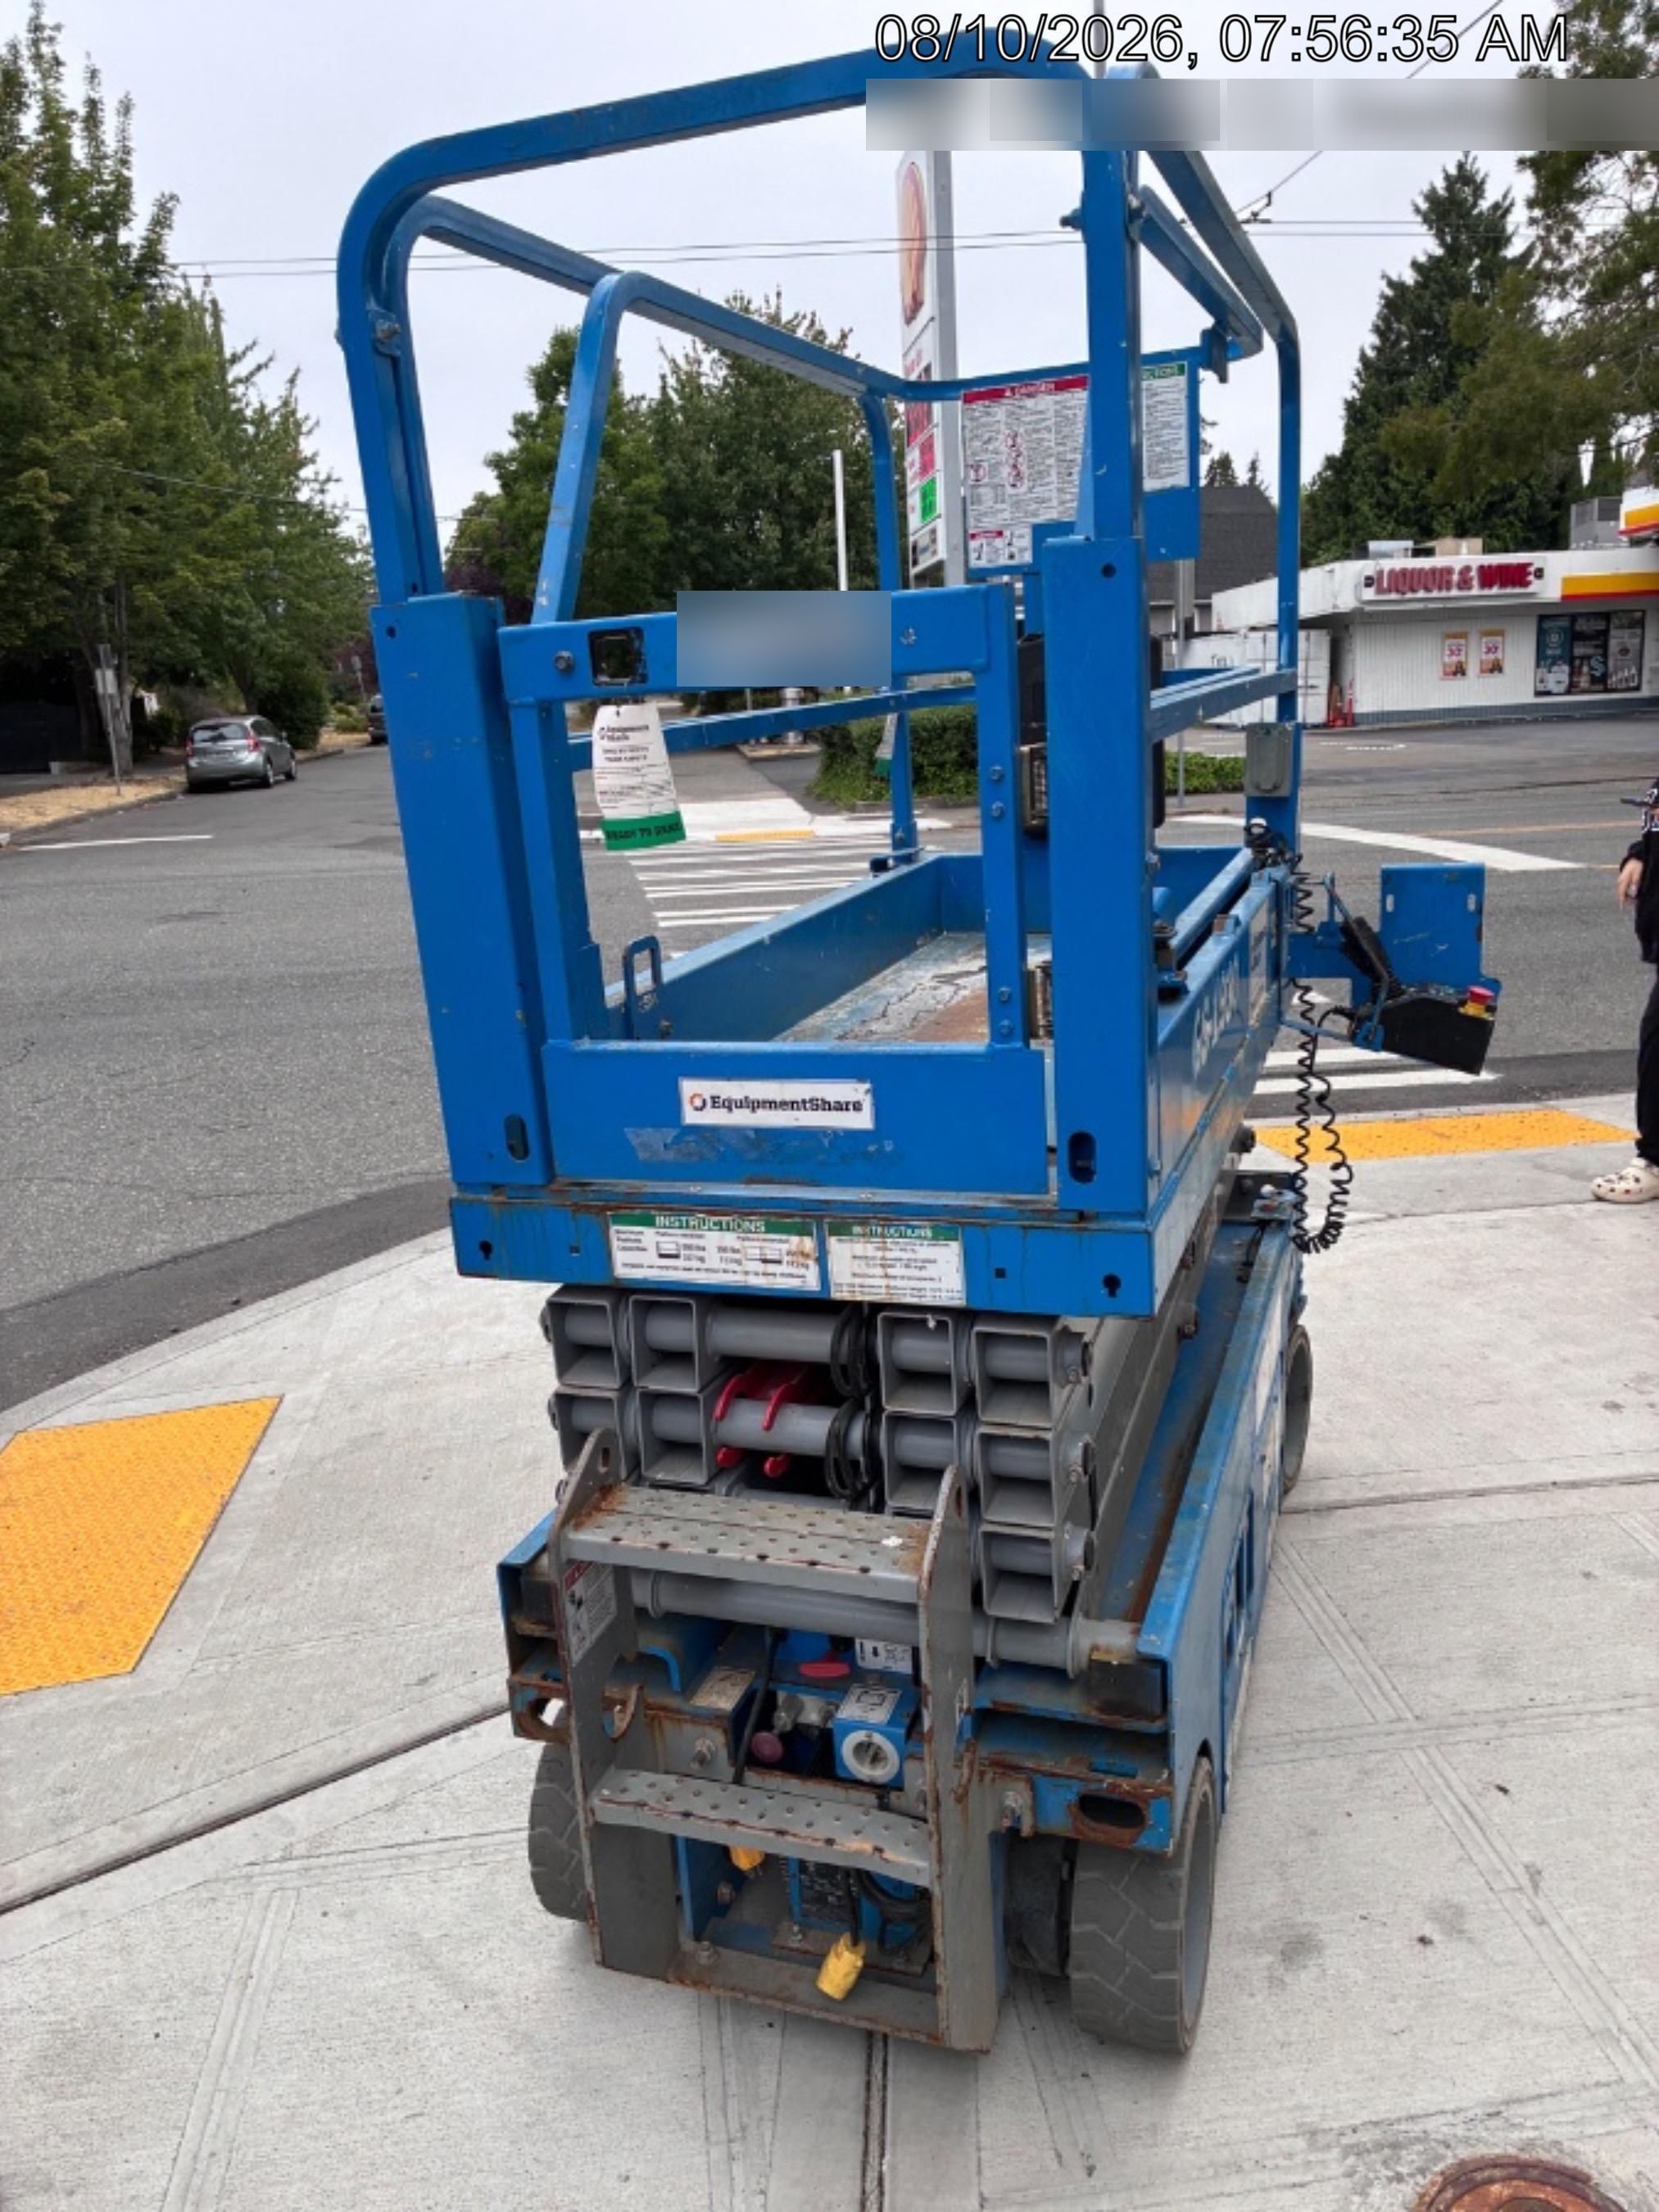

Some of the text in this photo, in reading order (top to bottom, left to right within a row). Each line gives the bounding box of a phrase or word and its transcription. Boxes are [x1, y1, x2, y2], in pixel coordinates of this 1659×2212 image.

[1375, 562, 1534, 596] LIQUOR & WINE
[709, 1095, 863, 1114] EquipmentShare
[655, 1214, 766, 1234] INSTRUCTIONS
